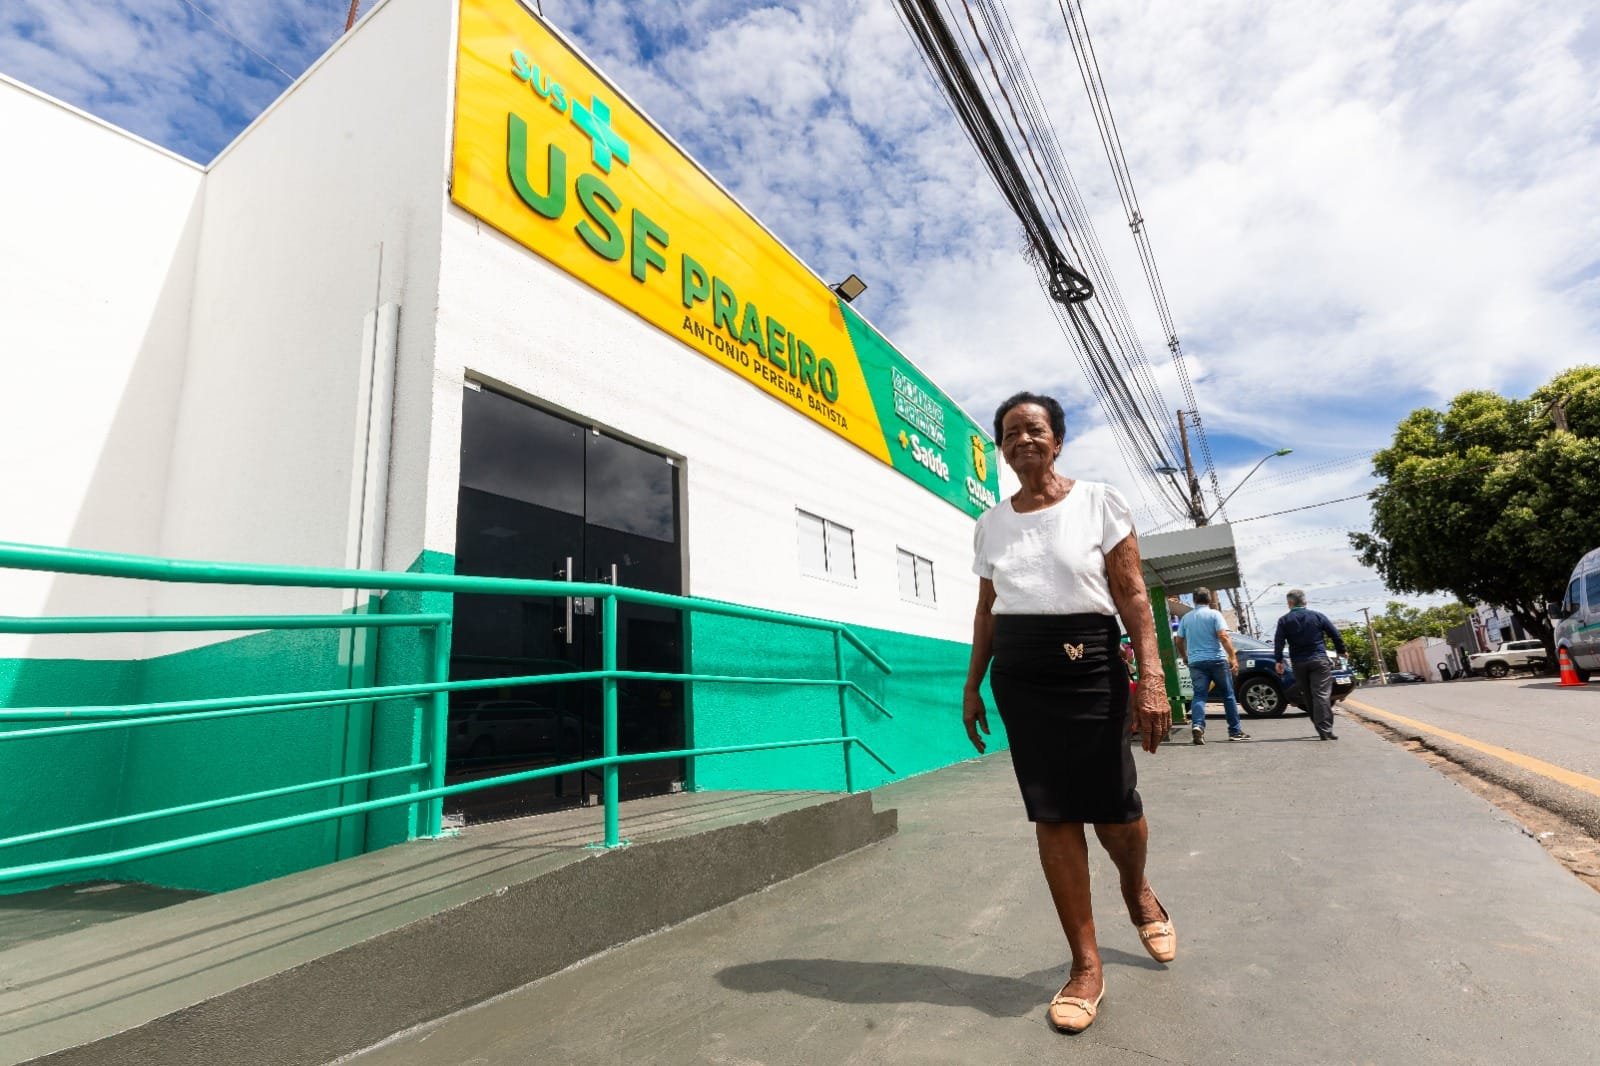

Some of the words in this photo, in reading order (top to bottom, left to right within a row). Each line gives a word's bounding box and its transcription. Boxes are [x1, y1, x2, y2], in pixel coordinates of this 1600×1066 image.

[511, 49, 568, 113] SUS
[507, 111, 669, 283] USF
[681, 253, 839, 403] PRAEIRO
[682, 315, 749, 367] ANTONIO
[753, 359, 803, 402] PEREIRA
[808, 395, 849, 430] BATISTA
[909, 434, 950, 482] Saúde
